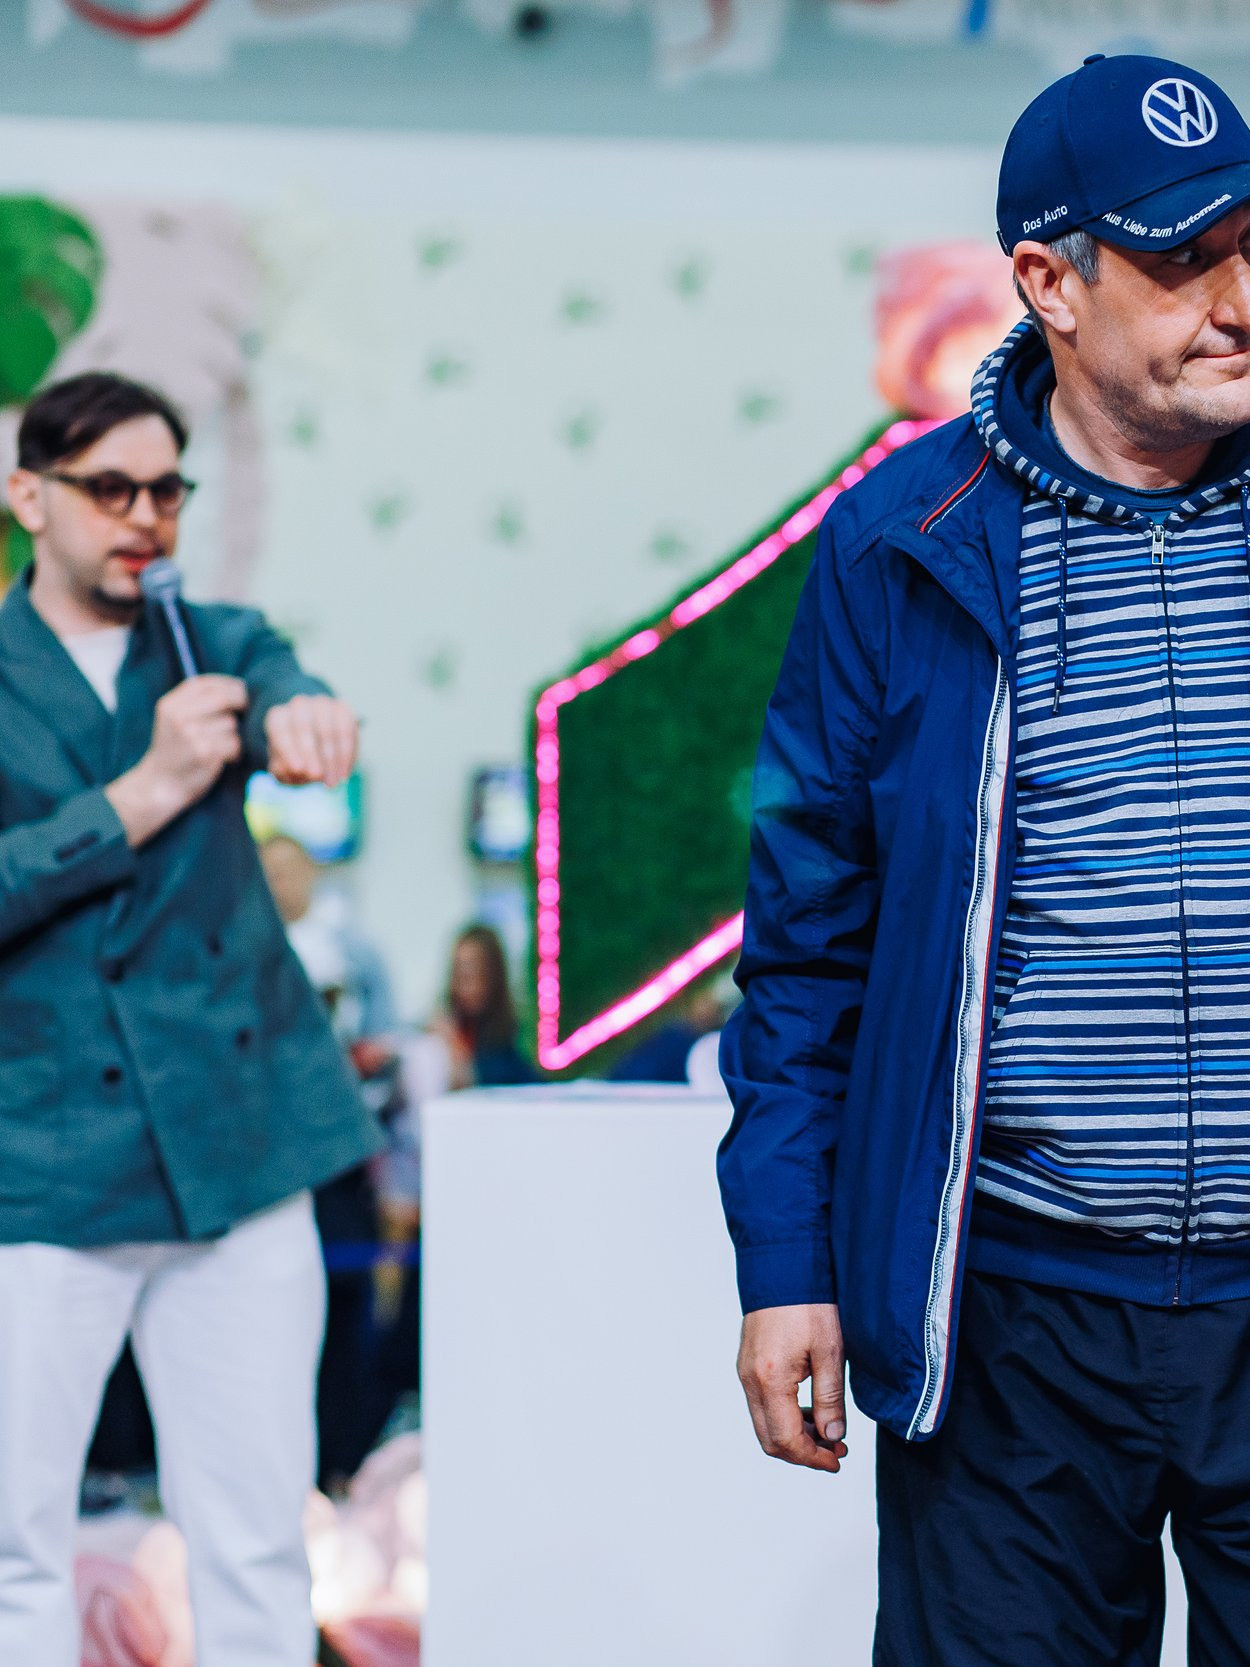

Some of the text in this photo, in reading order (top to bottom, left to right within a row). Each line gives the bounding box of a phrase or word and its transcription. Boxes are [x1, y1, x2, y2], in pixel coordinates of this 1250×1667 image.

[1022, 205, 1068, 234] Das Auto
[1101, 211, 1123, 226] Aus
[1123, 218, 1148, 236] Liebe
[1149, 227, 1173, 238] zum
